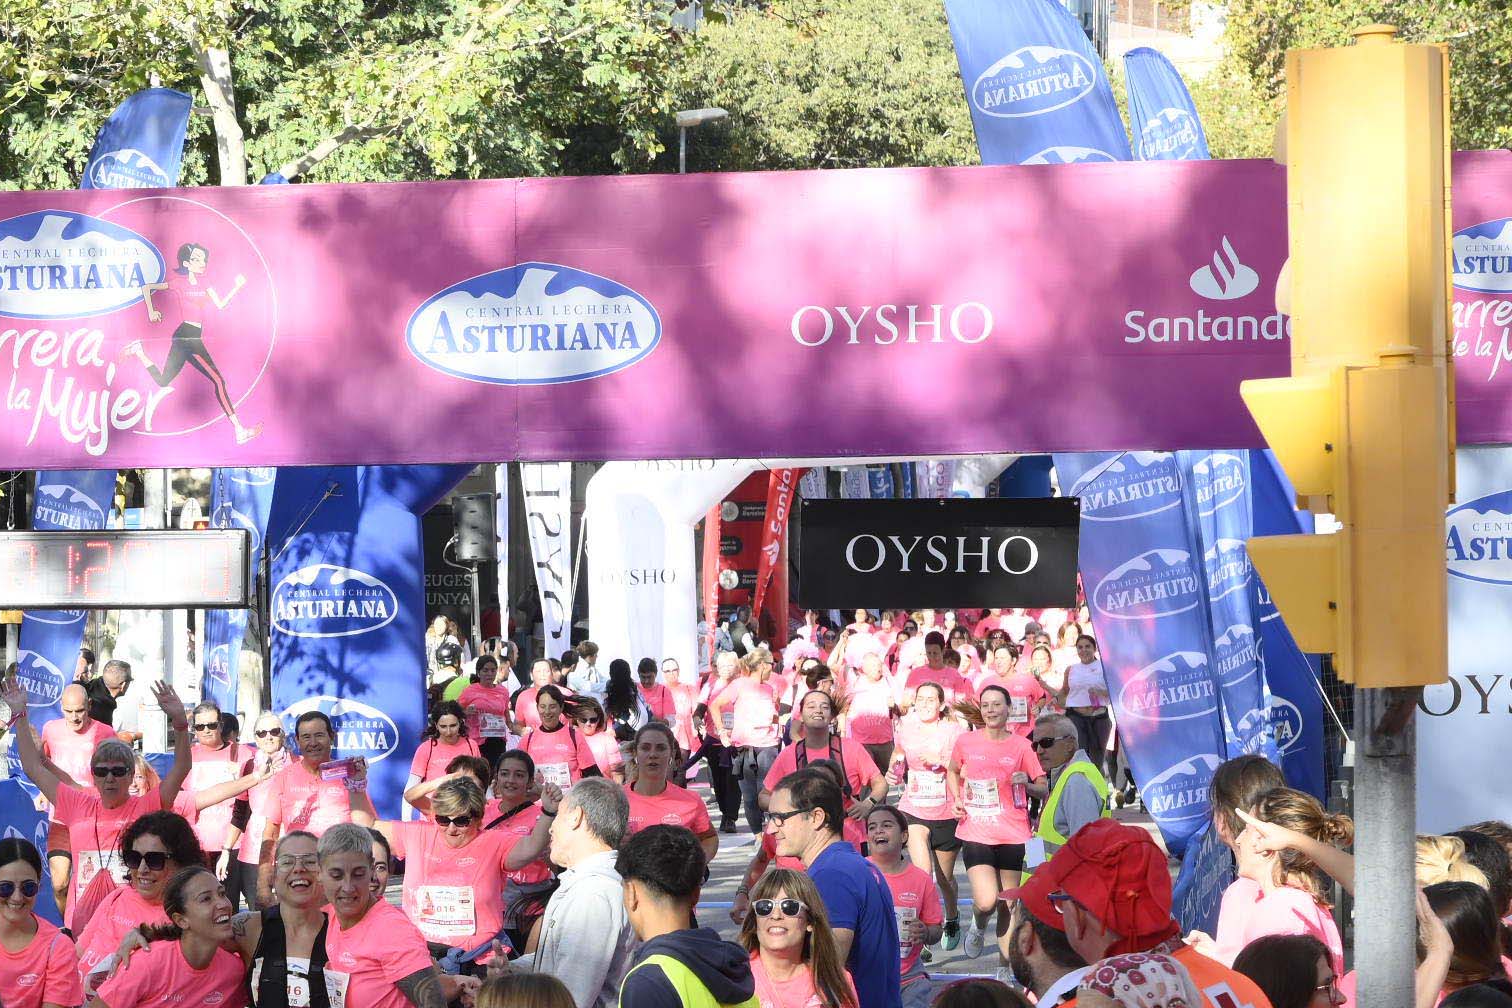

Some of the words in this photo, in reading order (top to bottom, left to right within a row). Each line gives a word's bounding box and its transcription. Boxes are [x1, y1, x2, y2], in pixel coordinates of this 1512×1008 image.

[66, 246, 144, 258] LECHERA
[1464, 244, 1512, 252] CENTRA
[465, 304, 544, 318] CENTRAL
[552, 302, 634, 316] LECHERA
[426, 310, 642, 354] ASTURIANA
[790, 302, 994, 347] OYSHO
[1124, 308, 1292, 343] Santand
[1474, 330, 1494, 356] la
[6, 372, 32, 412] la
[25, 364, 174, 456] Mujer
[770, 468, 792, 536] Santa
[36, 506, 100, 530] STURIANA
[1472, 522, 1512, 532] CENT
[524, 464, 564, 640] OYSH
[844, 533, 1040, 577] OYSHO
[288, 590, 330, 598] CENTRAL
[334, 589, 384, 598] LECHERA
[424, 574, 472, 588] EUGES
[276, 594, 388, 620] ASTURIANA
[426, 592, 472, 606] UNYA
[16, 675, 60, 700] URIANA
[336, 720, 384, 729] LECHERA
